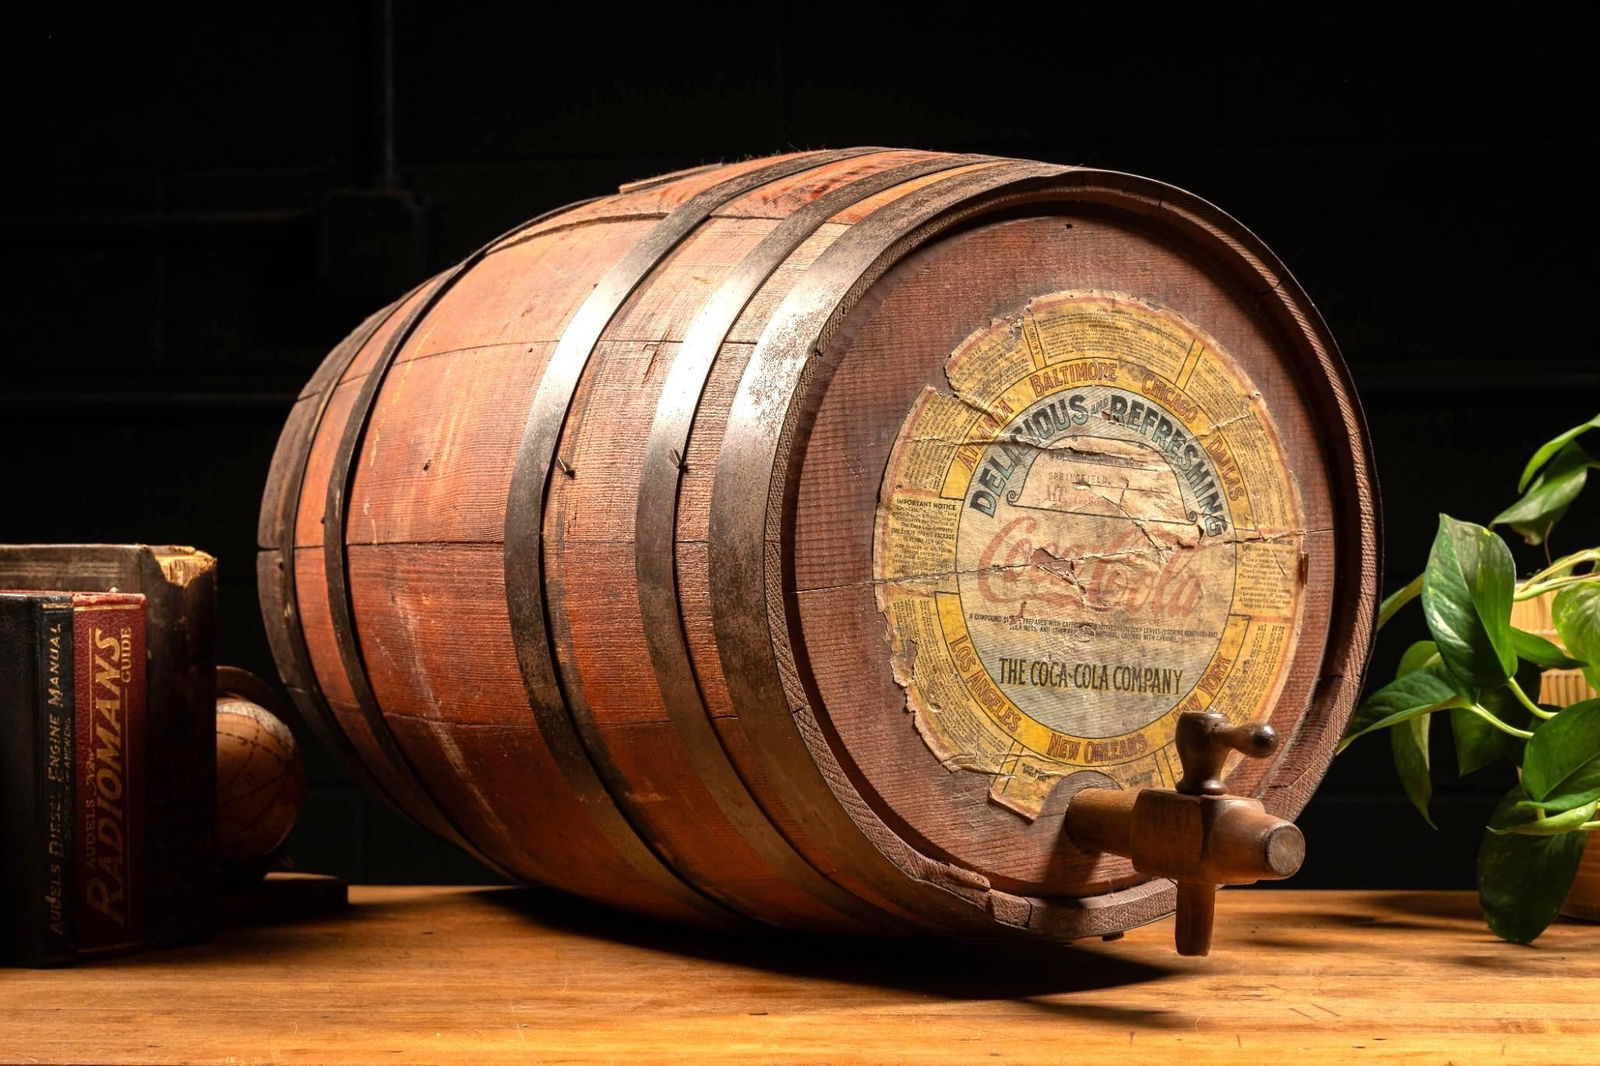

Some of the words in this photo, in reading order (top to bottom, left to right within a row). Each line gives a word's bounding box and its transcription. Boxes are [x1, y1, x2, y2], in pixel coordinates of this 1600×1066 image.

[1029, 361, 1118, 397] BALTIMORE
[1141, 373, 1198, 423] CHICAGO
[969, 394, 1089, 519] DELICIOUS
[1109, 394, 1229, 538] REFRESHING
[1206, 434, 1245, 502] DALLAS
[48, 623, 64, 708] MANUAL
[120, 626, 132, 683] GUIDE
[949, 635, 977, 672] LOS
[966, 672, 1022, 732] ANGELES
[998, 657, 1026, 685] THE
[1030, 660, 1109, 691] COCA-COLA
[1113, 665, 1185, 695] COMPANY
[1197, 652, 1232, 699] YORK
[48, 713, 65, 782] ENGINE
[86, 626, 125, 928] RADIOMANS
[1046, 733, 1081, 761] NEW
[1083, 733, 1149, 764] ORLEANS
[86, 799, 97, 872] AUDELS
